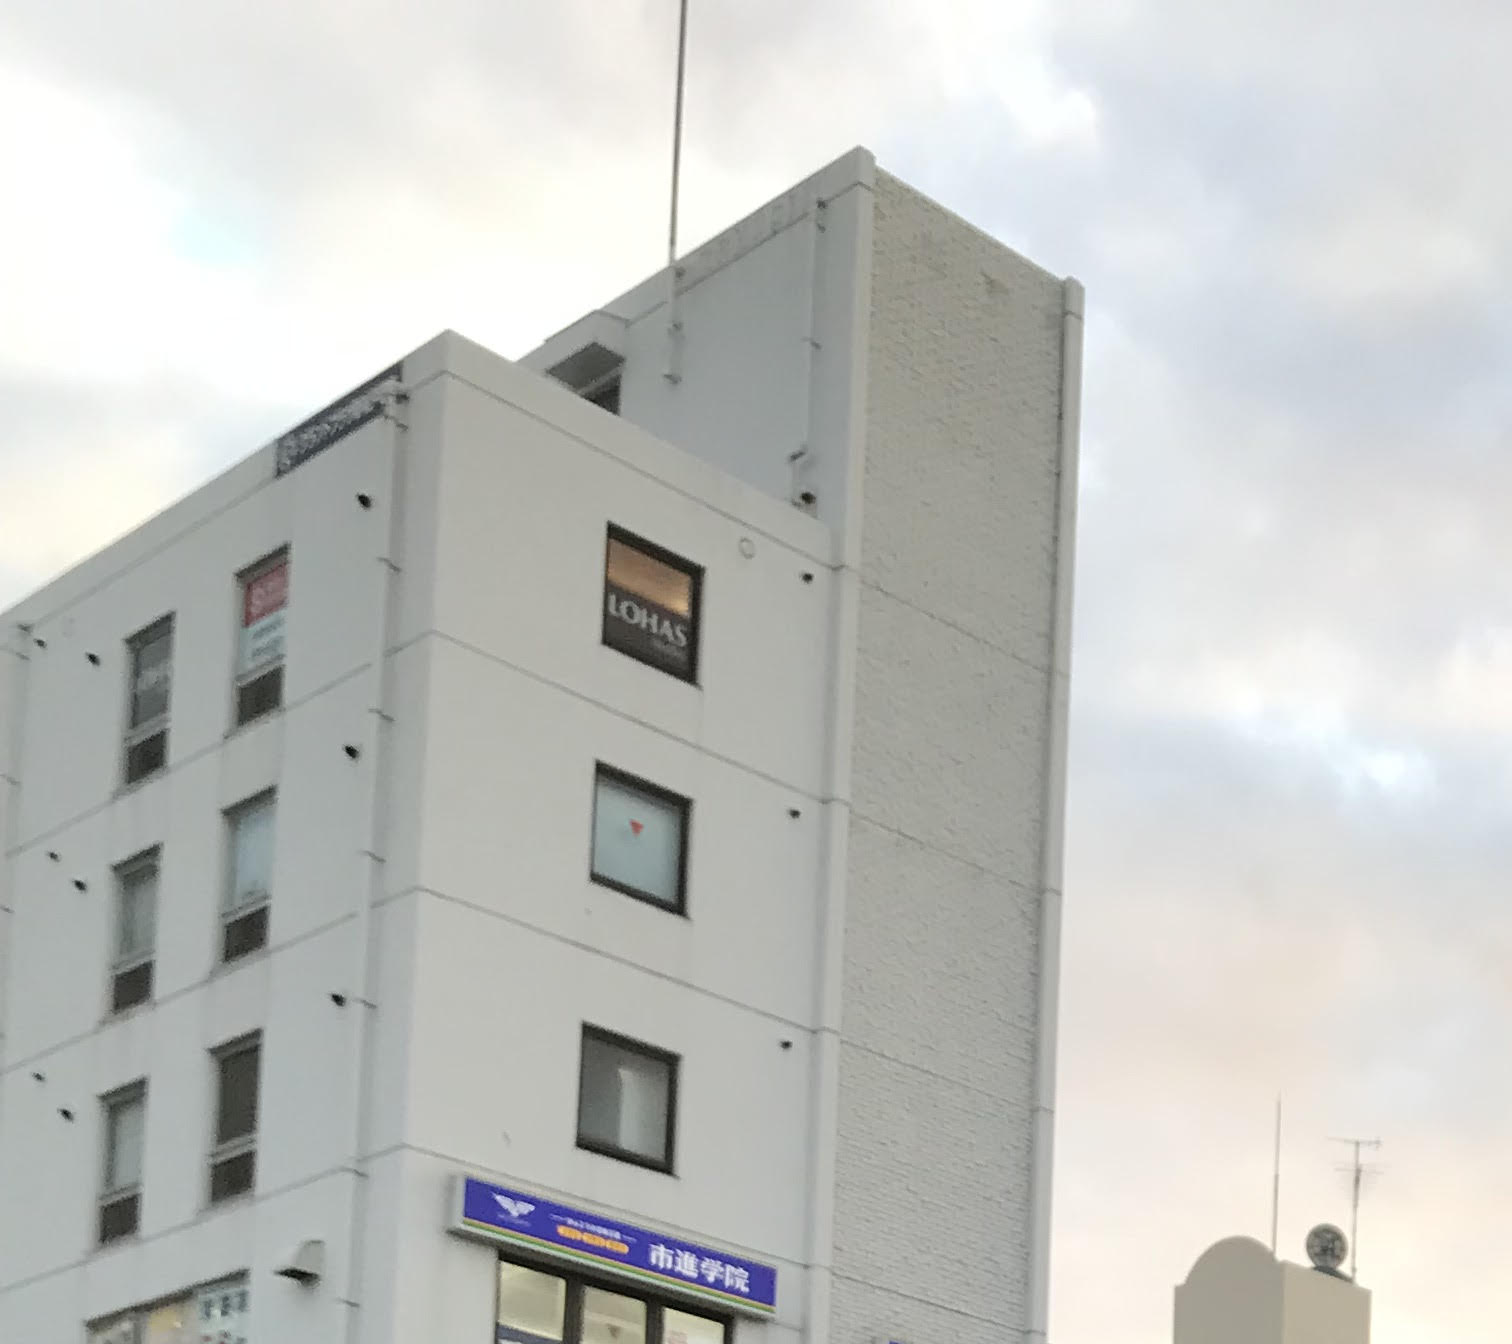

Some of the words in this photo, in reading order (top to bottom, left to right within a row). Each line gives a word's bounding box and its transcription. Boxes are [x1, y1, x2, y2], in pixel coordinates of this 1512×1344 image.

[608, 593, 687, 647] LOHAS
[650, 1243, 749, 1293] 市進学院
